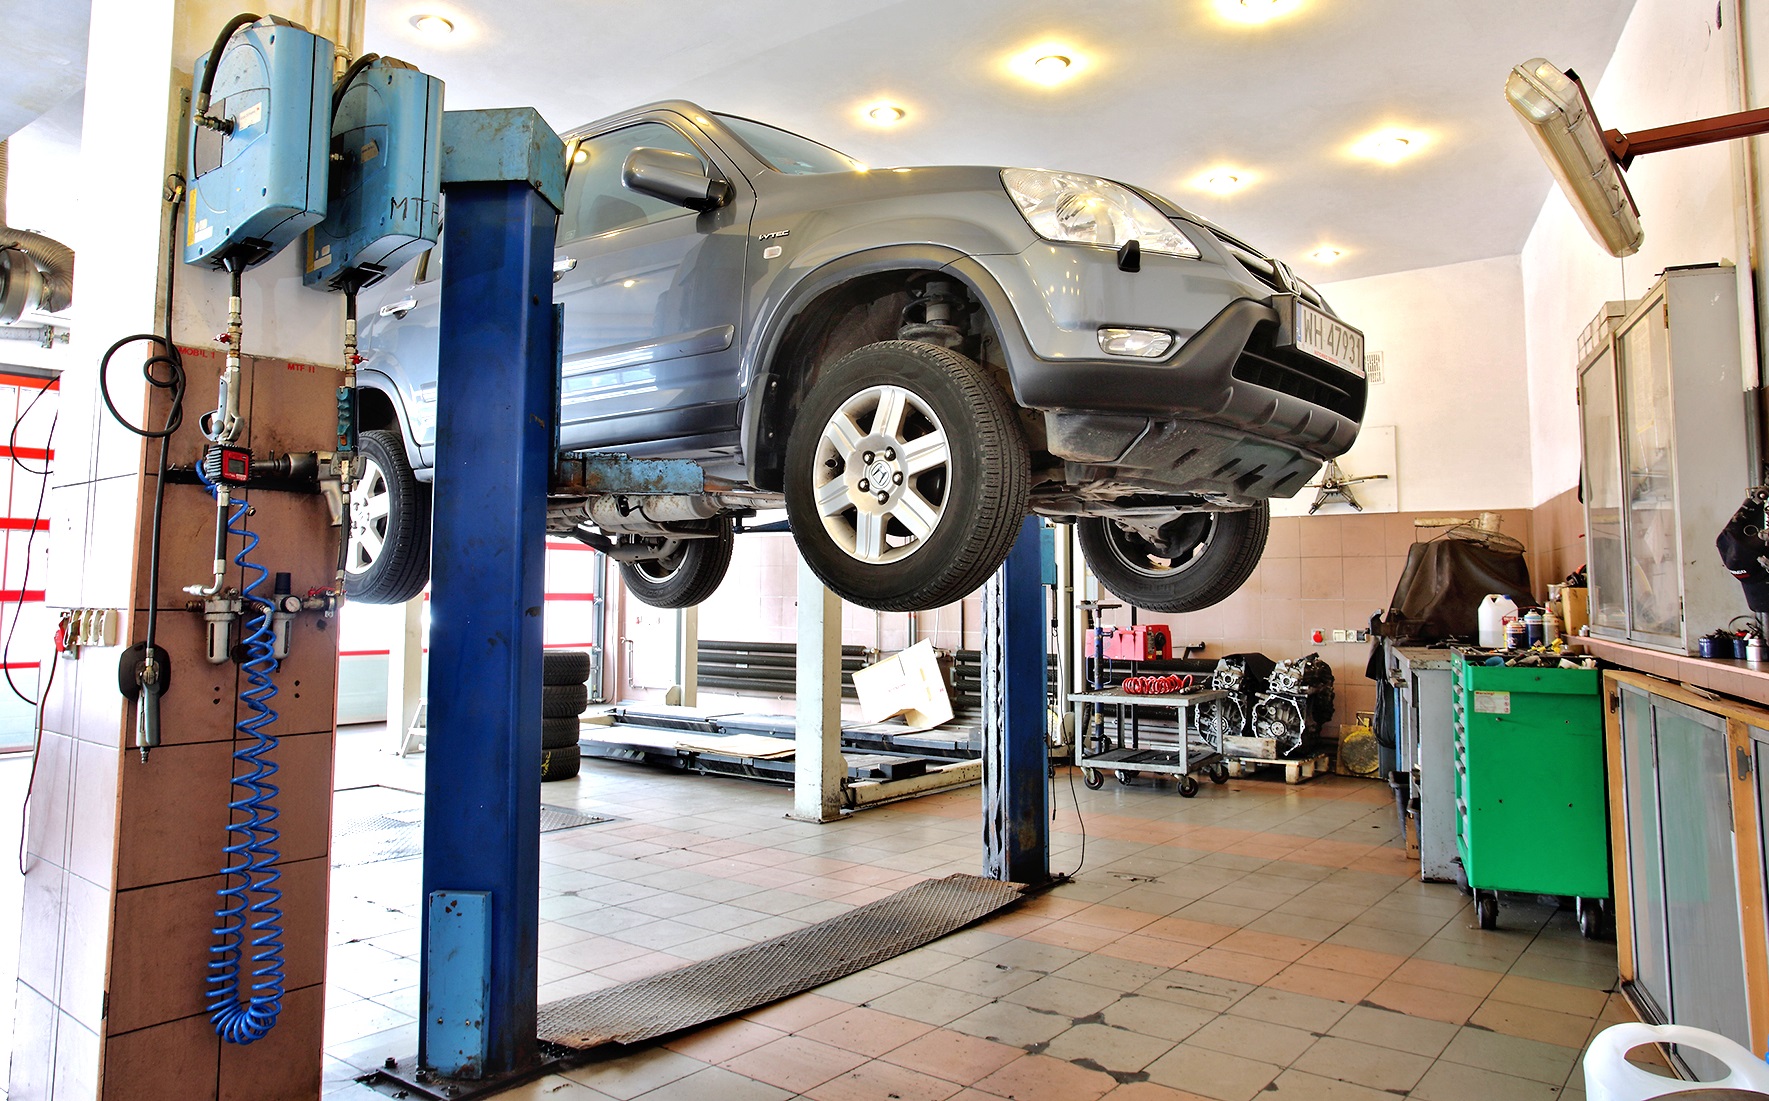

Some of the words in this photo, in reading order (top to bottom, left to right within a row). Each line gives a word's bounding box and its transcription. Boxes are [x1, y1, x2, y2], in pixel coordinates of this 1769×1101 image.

[390, 196, 440, 227] MTF
[1303, 309, 1324, 350] WH
[1327, 323, 1362, 369] 47931
[178, 346, 208, 359] MOBIL
[287, 362, 306, 372] MTF
